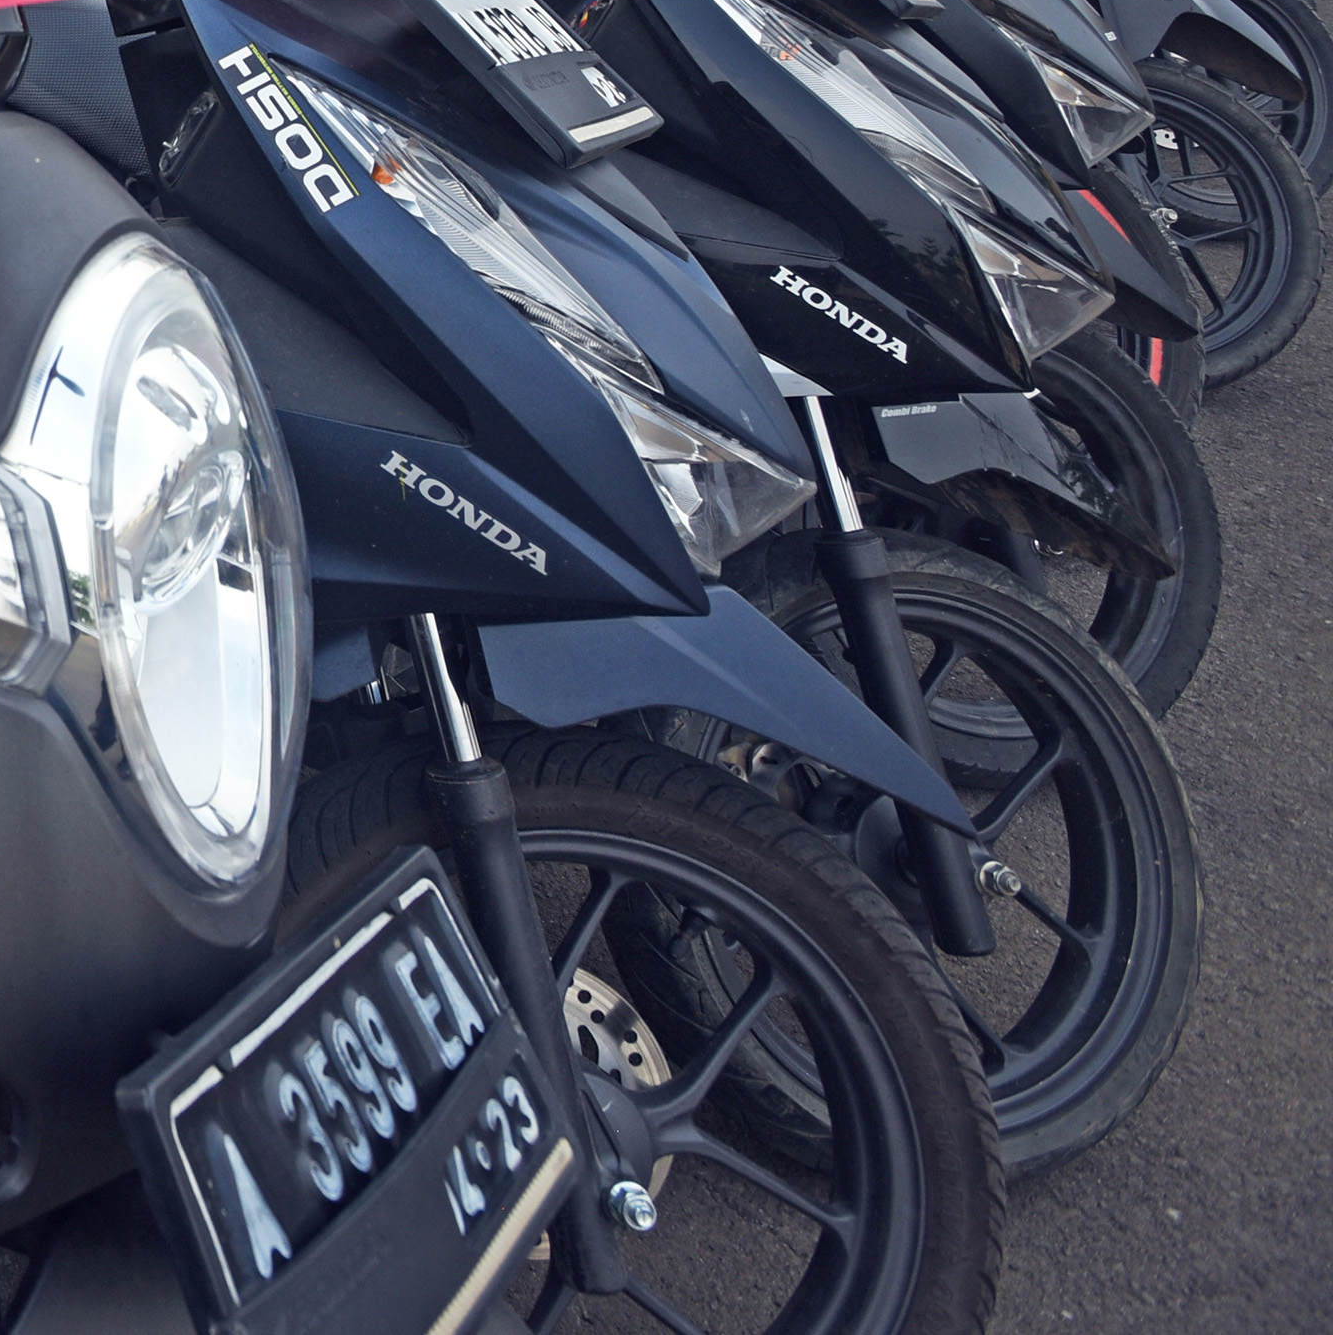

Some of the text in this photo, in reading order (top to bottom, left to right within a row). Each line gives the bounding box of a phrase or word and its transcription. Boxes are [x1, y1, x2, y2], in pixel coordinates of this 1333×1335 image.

[769, 265, 910, 364] HONDA
[881, 404, 938, 418] Combi Brake
[380, 449, 548, 576] HONDA
[222, 1132, 293, 1280] A
[278, 994, 418, 1202] 3599
